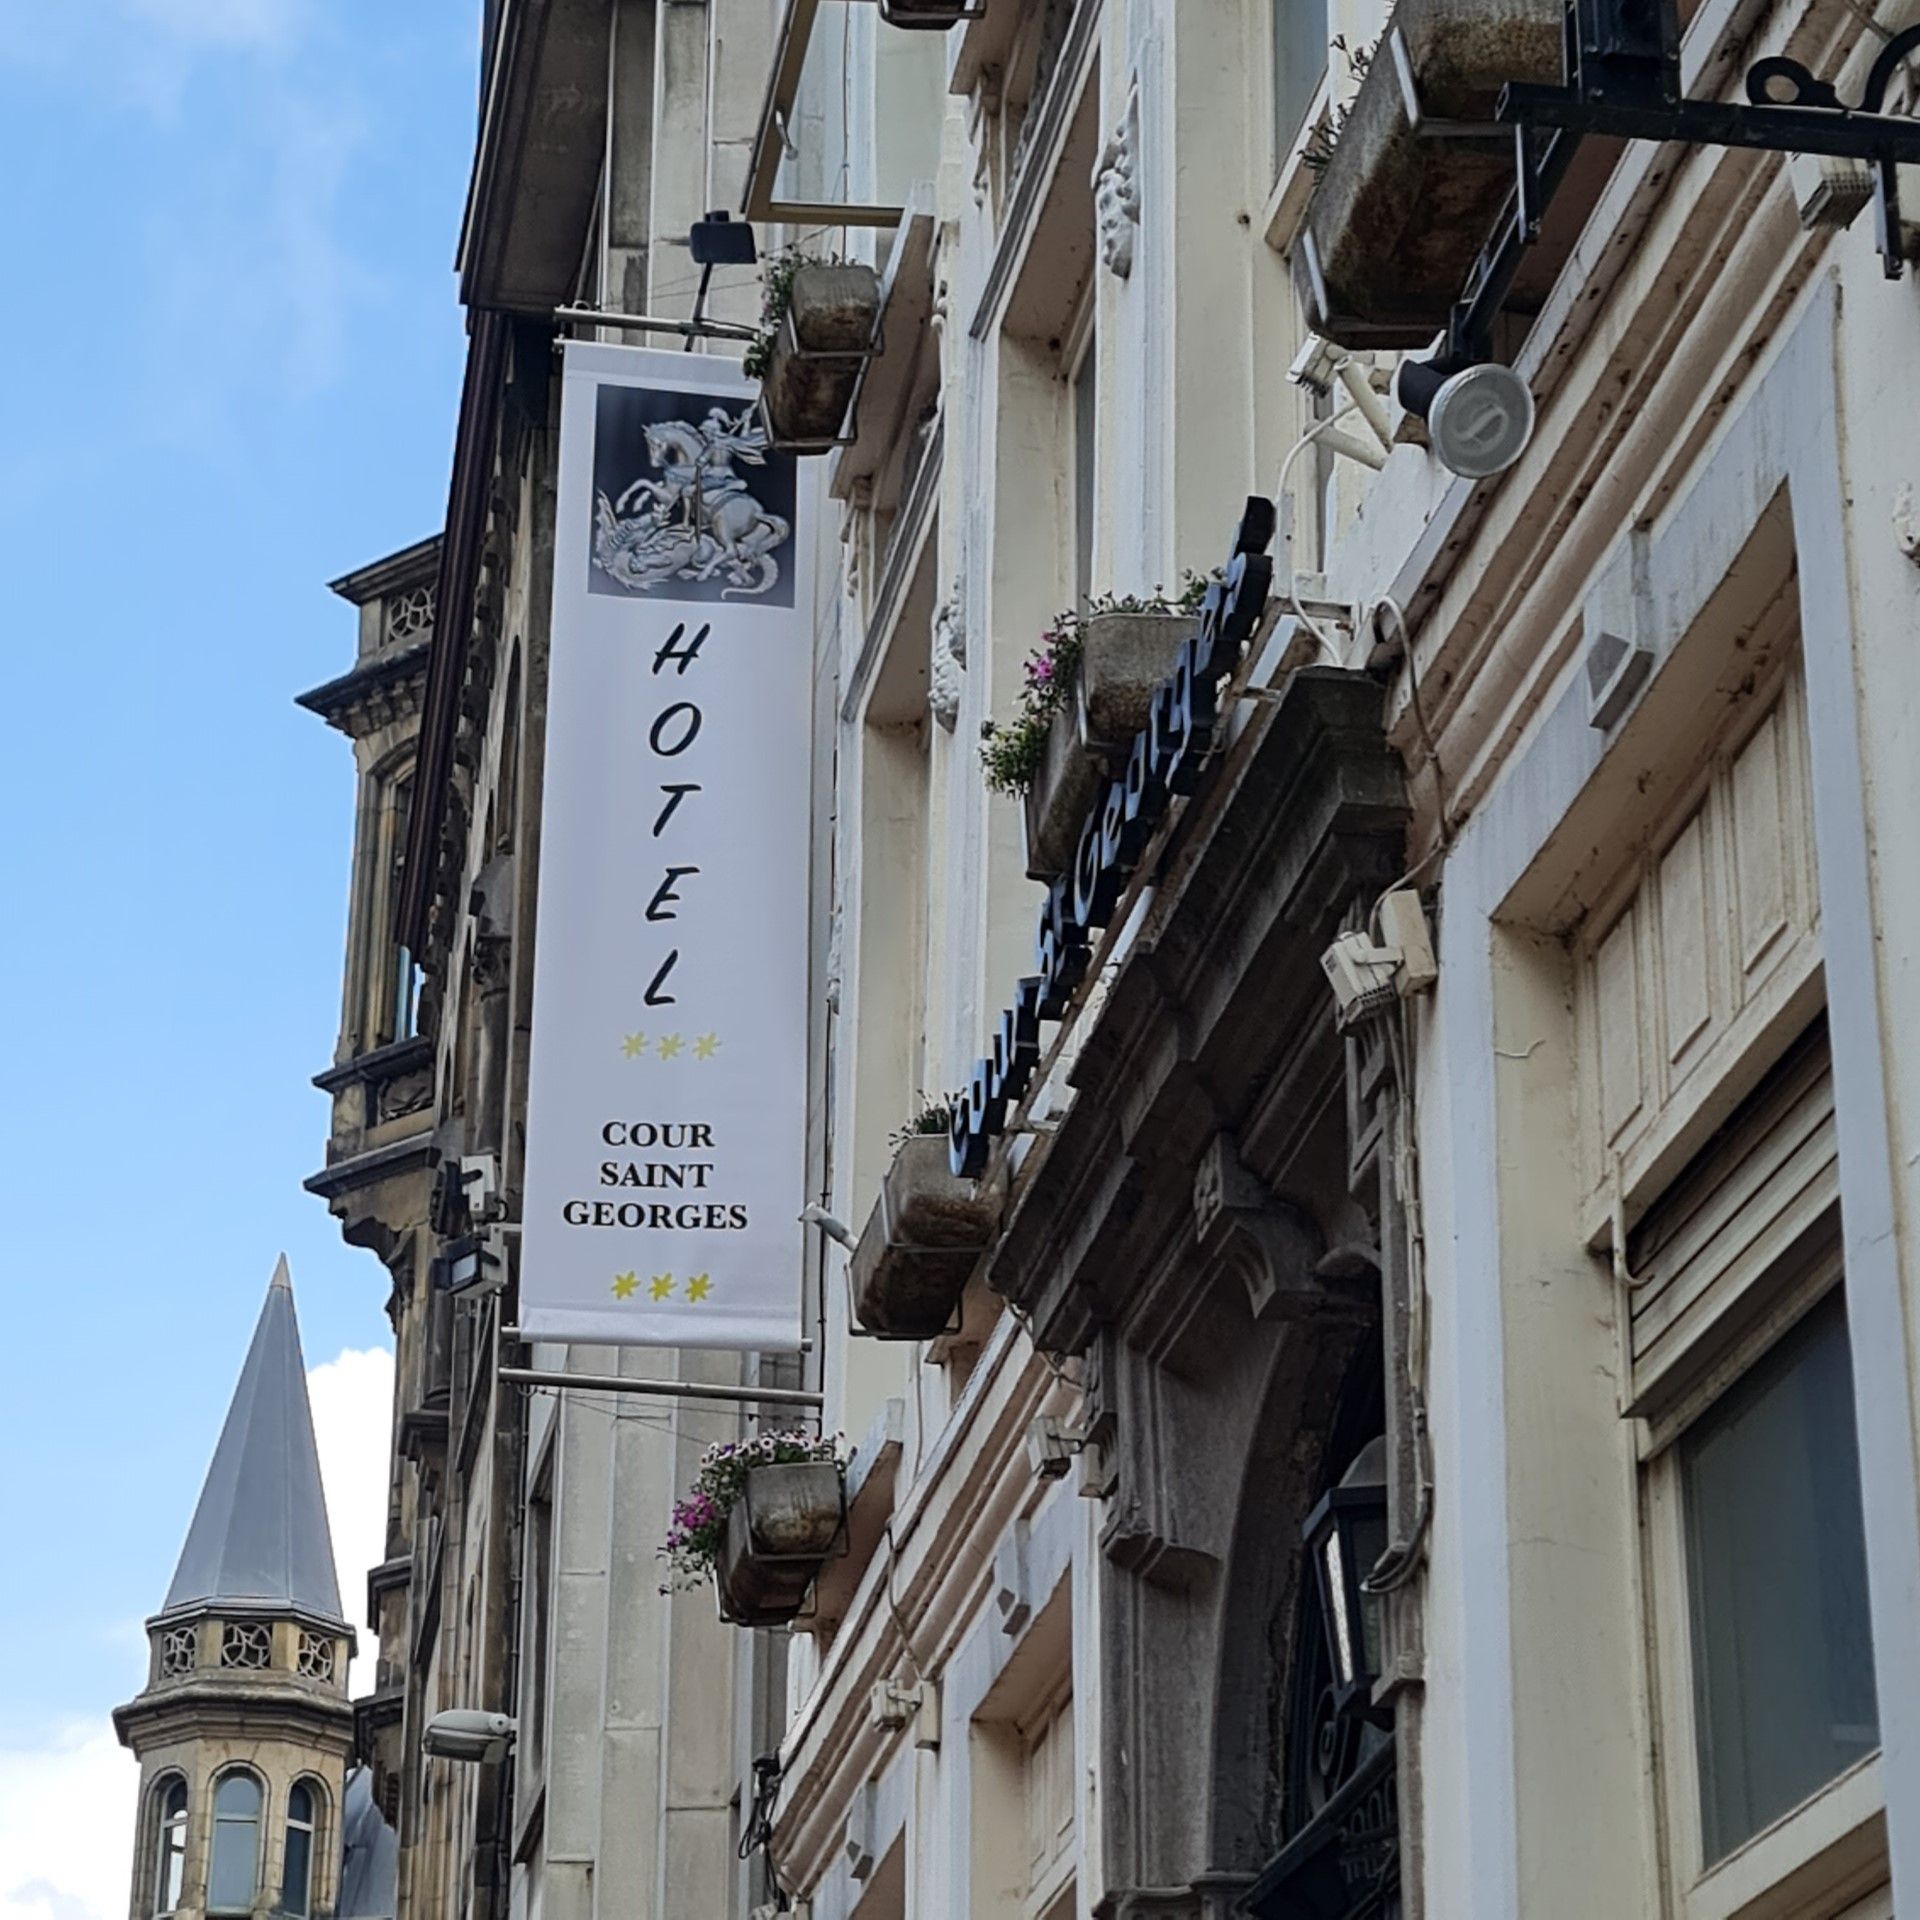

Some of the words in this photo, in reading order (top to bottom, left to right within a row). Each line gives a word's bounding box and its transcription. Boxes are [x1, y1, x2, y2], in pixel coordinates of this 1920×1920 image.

[643, 622, 711, 1007] HOTEL
[602, 1121, 715, 1148] COUR
[600, 1161, 713, 1188] SAINT
[562, 1200, 748, 1230] GEORGES
